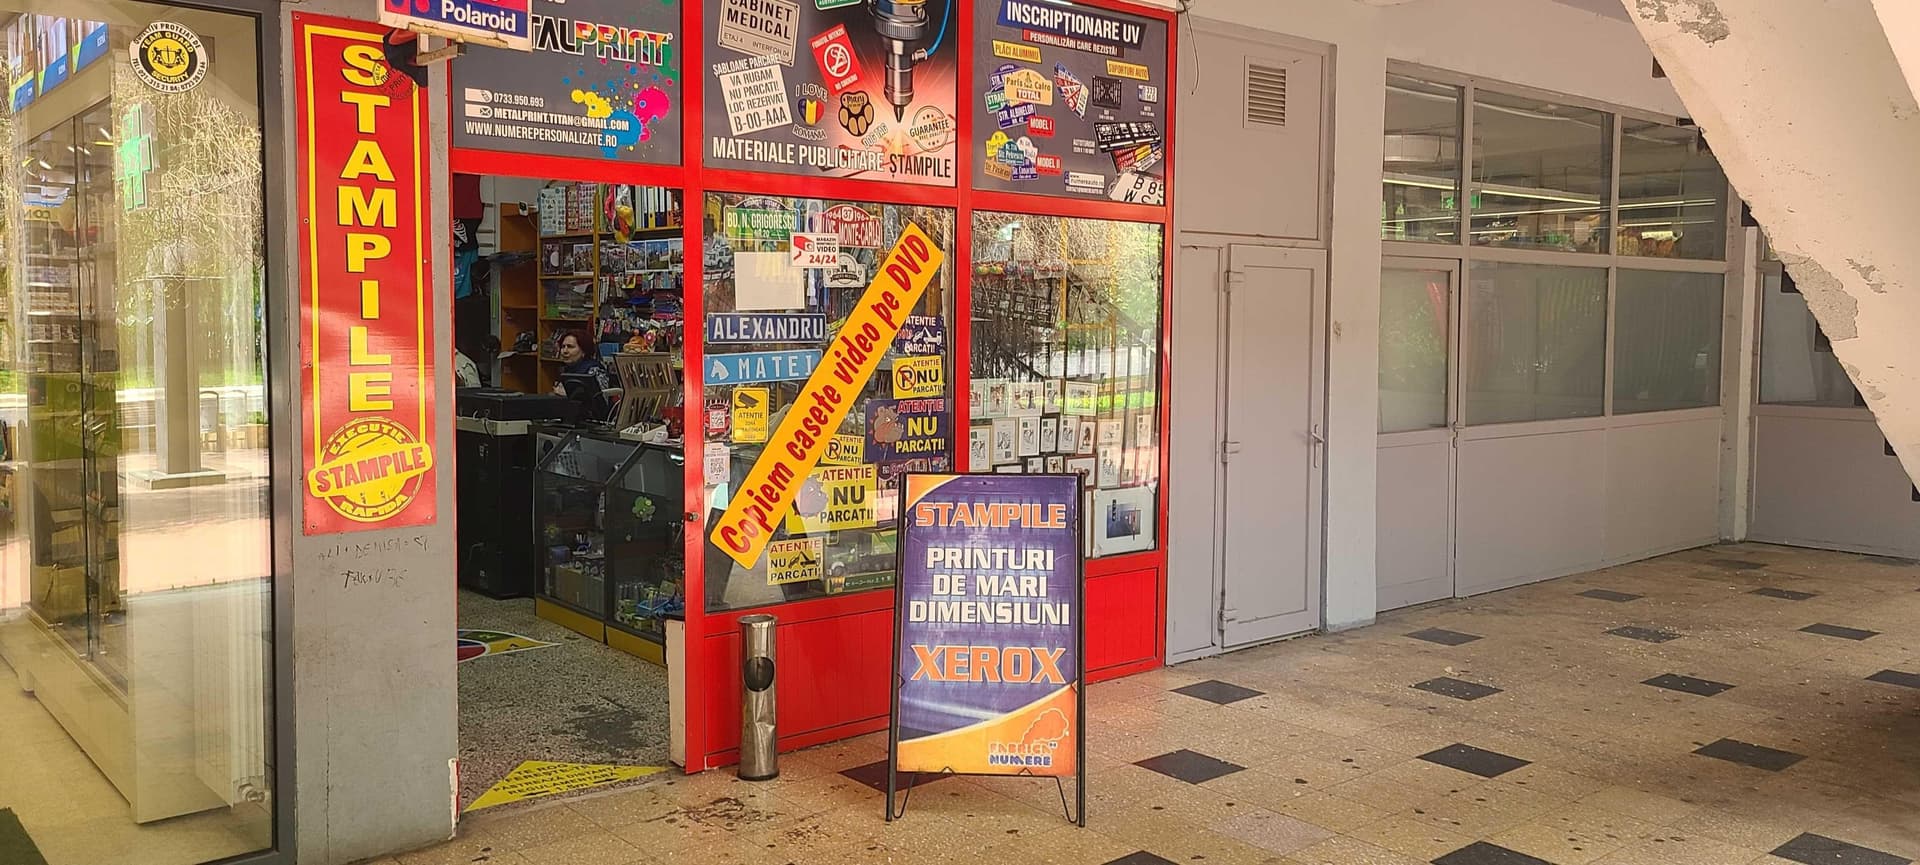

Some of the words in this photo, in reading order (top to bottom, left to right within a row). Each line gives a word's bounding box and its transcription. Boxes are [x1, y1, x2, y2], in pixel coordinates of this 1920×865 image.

[441, 0, 517, 33] Polaroid
[727, 8, 791, 40] MEDICAL
[141, 31, 163, 49] TEAM
[164, 31, 194, 53] GUARD
[724, 32, 738, 42] ETAJ
[1122, 23, 1140, 44] UV
[752, 41, 782, 56] INTERFON
[1076, 40, 1092, 51] CARE
[151, 70, 189, 83] SECURITY
[730, 75, 742, 87] VA
[744, 69, 774, 84] RUGAM
[1006, 77, 1023, 87] Paris
[1034, 81, 1051, 91] Cairo
[729, 87, 742, 100] NU
[743, 81, 780, 97] PARCATI!
[802, 83, 828, 102] LOVE
[1017, 89, 1041, 101] TOTAL
[730, 101, 745, 114] LOC
[746, 92, 785, 109] REZERVAT
[909, 119, 950, 138] GUARANTEE
[1030, 118, 1049, 130] MODEL
[713, 136, 795, 165] MATERIALE
[798, 145, 886, 172] PUBLICITARE
[1037, 157, 1056, 169] MODEL
[1134, 177, 1144, 189] B
[727, 212, 741, 228] BD.
[751, 213, 797, 231] GRIGORESCU
[843, 208, 852, 219] 37
[338, 44, 398, 412] STAMPILE
[809, 254, 837, 264] 24/24
[712, 316, 825, 341] ALEXANDRU
[738, 354, 812, 381] MATEI
[916, 369, 939, 384] NU
[720, 460, 796, 555] Copiem
[786, 384, 843, 462] casete
[833, 321, 882, 386] video
[870, 290, 900, 331] pe
[885, 233, 931, 293] DVD
[907, 416, 938, 437] NU
[329, 423, 406, 456] EXECUTIE
[843, 444, 859, 455] NU
[315, 446, 426, 493] STAMPILE
[339, 493, 409, 517] RAPIDA
[832, 485, 866, 506] NU
[914, 501, 1068, 529] STAMPILE
[770, 558, 787, 568] NU
[925, 546, 1055, 572] PRINTURI
[932, 573, 967, 596] DE
[975, 574, 1047, 598] MARI
[908, 600, 1070, 626] DIMENSIUNI
[909, 644, 1067, 685] XEROX
[536, 763, 569, 771] ROG
[989, 754, 1052, 766] NUMERE
